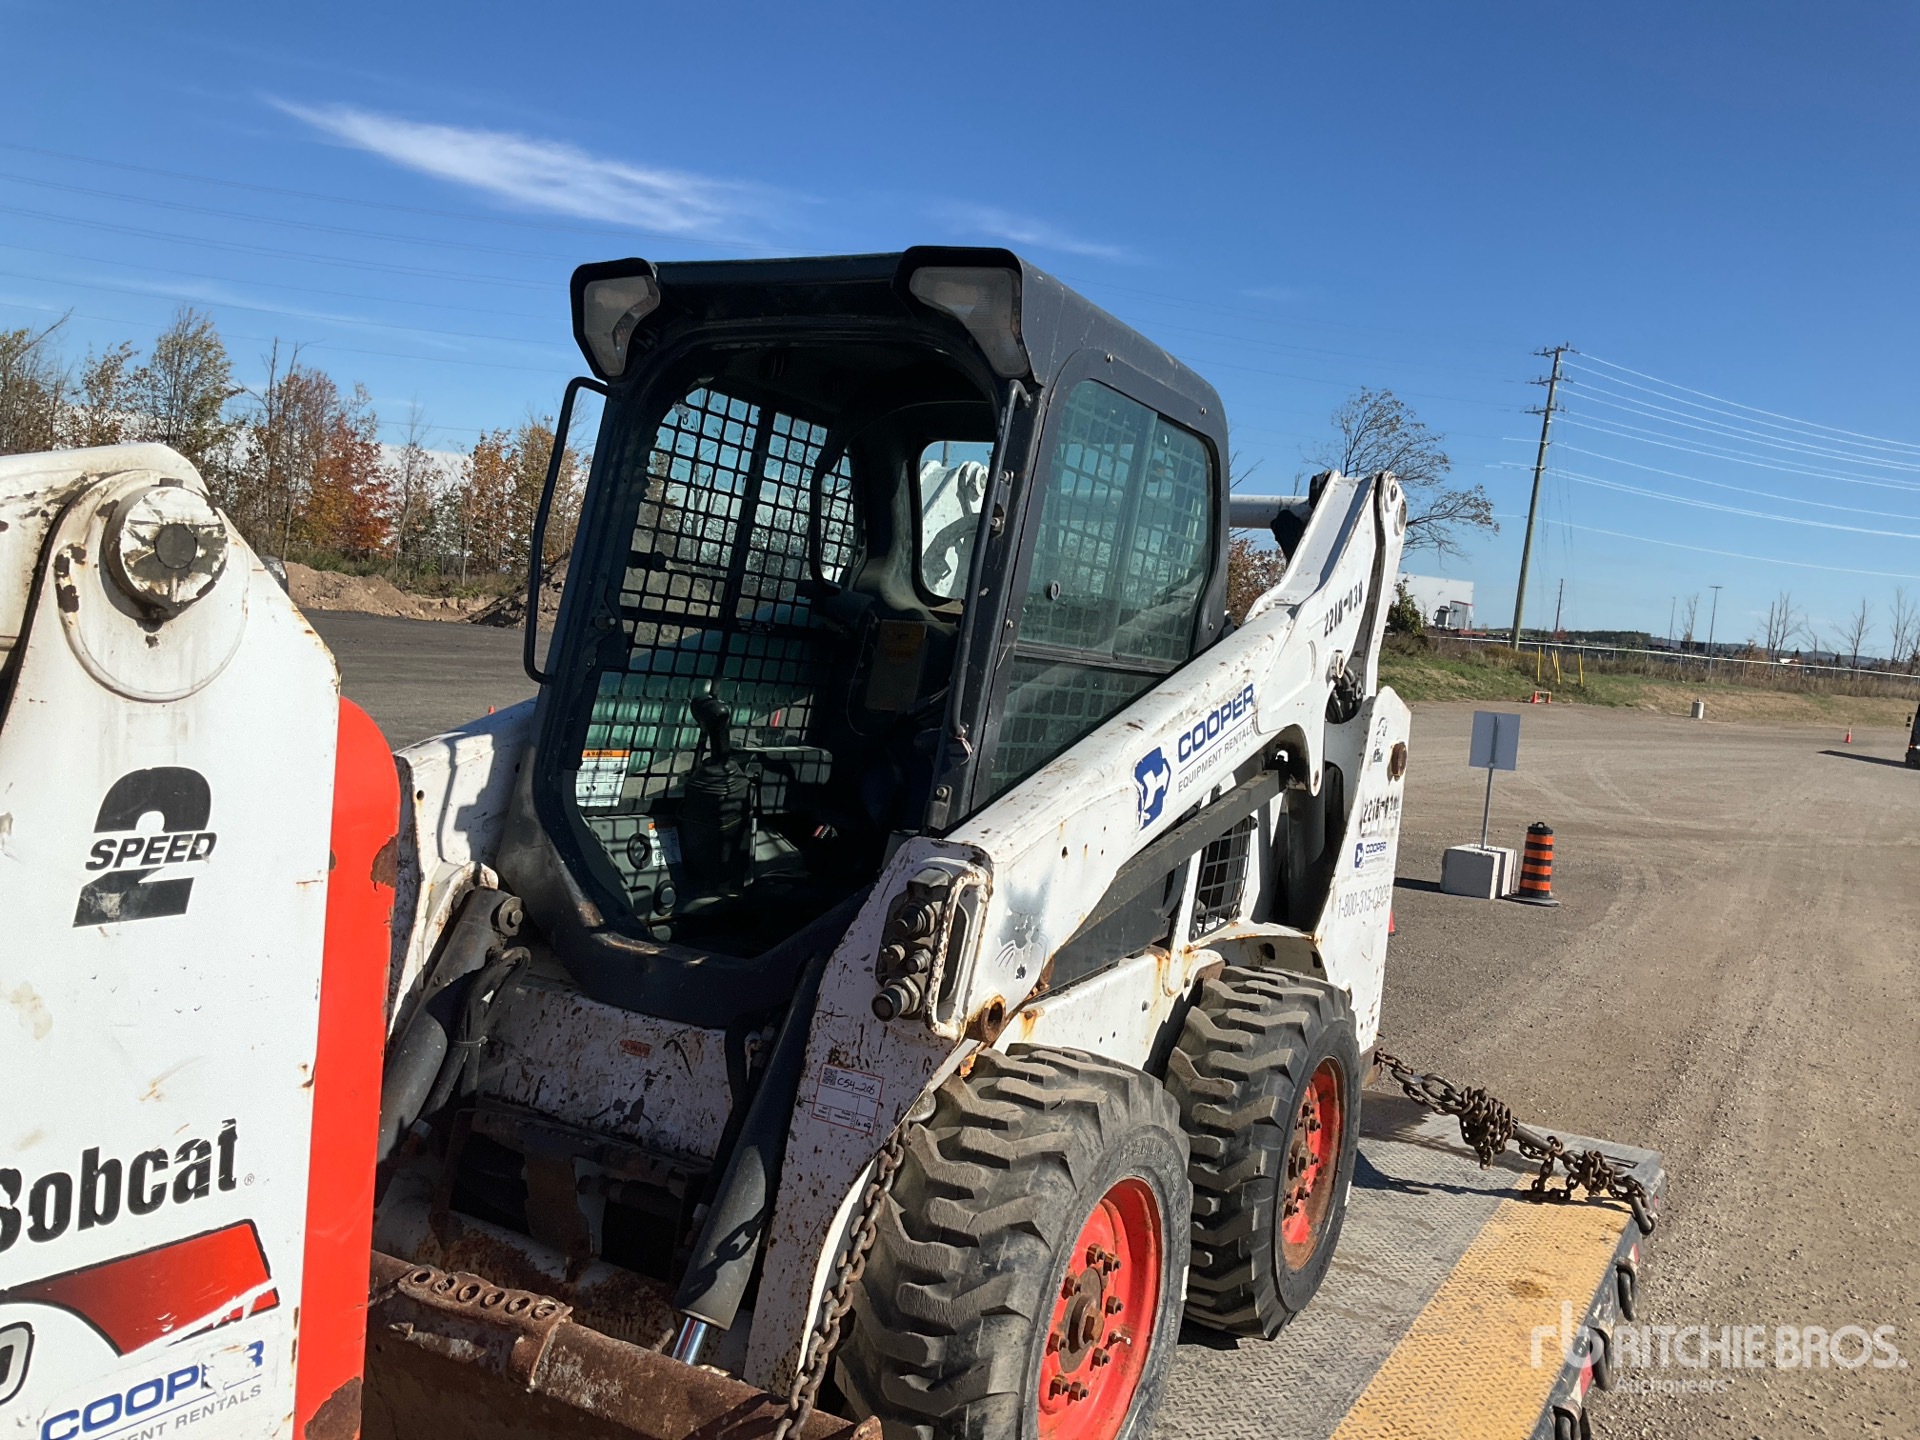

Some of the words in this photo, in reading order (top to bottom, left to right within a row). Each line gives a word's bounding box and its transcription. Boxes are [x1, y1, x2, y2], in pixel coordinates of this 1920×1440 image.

[1178, 683, 1254, 763] COOPER
[1178, 747, 1223, 793] EQUIPMENT
[72, 766, 212, 928] 2
[85, 832, 218, 871] SPEED
[1366, 842, 1387, 854] COOPER
[41, 1340, 265, 1440] COOPR
[175, 1384, 262, 1430] RENTALS
